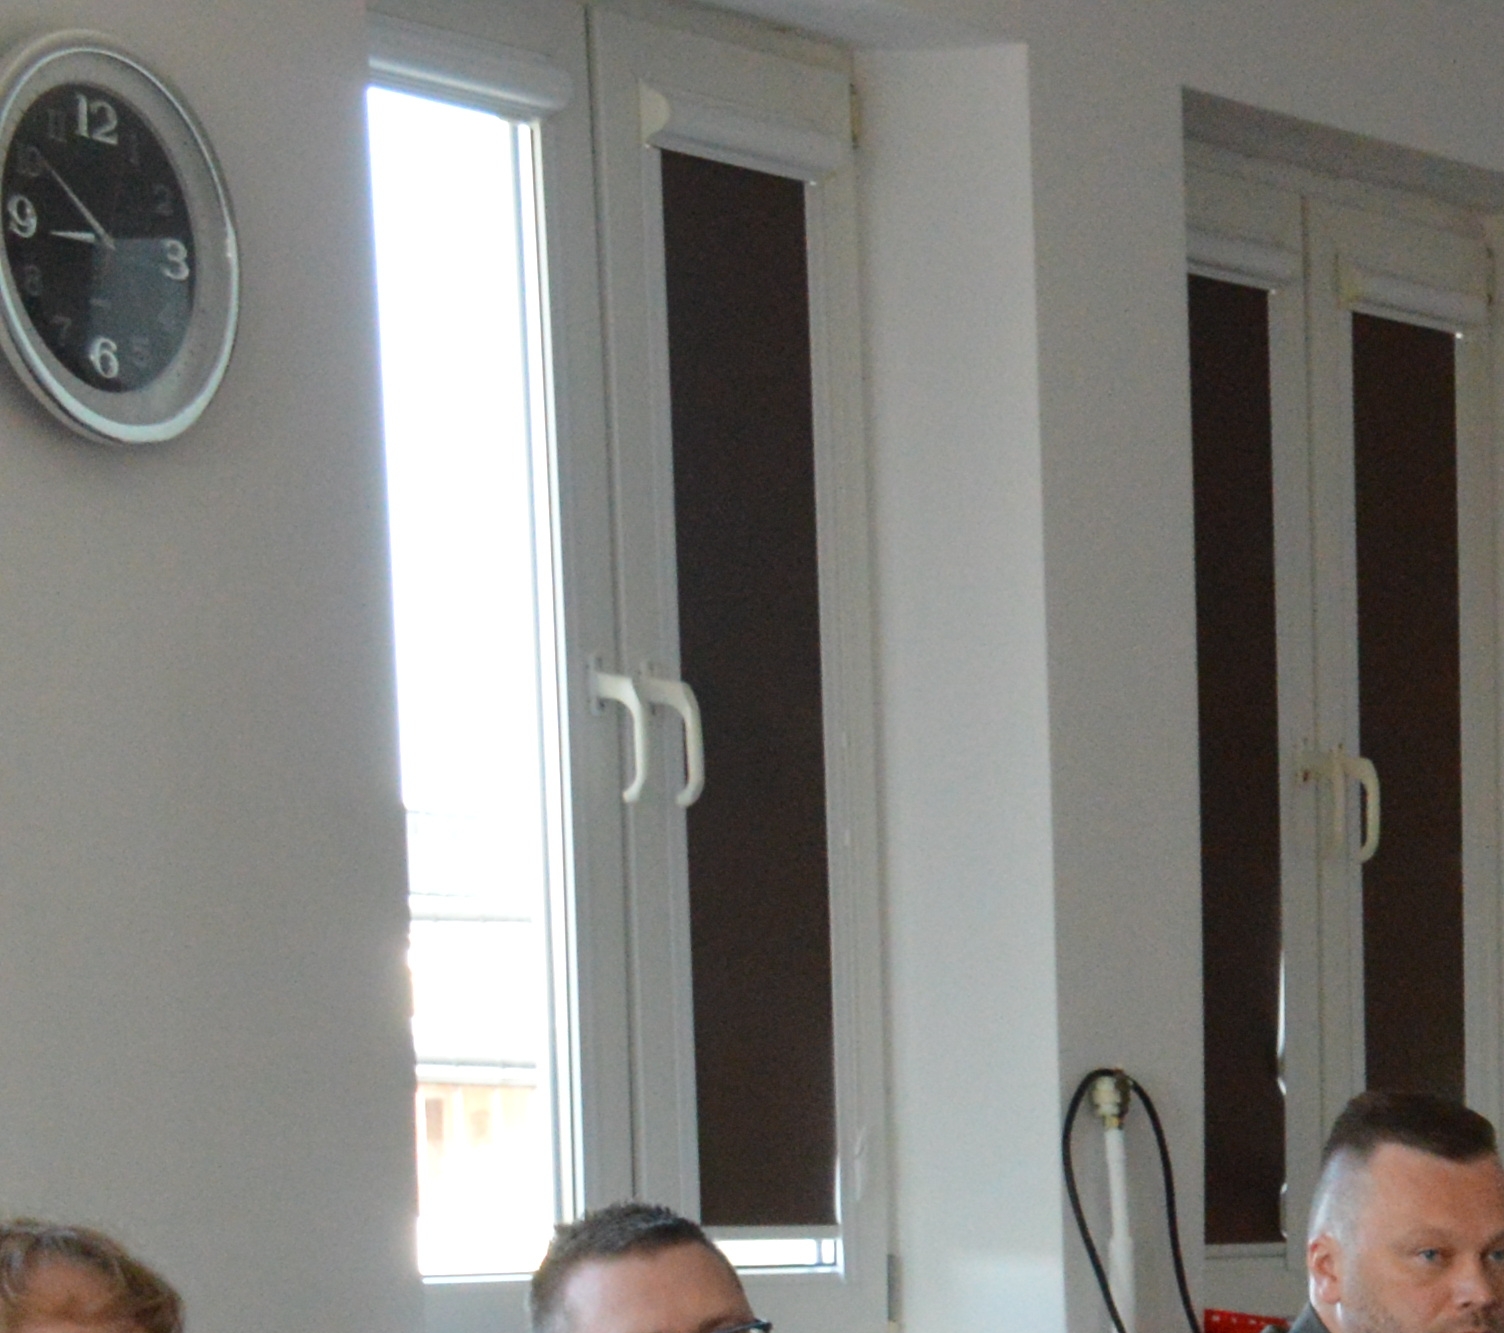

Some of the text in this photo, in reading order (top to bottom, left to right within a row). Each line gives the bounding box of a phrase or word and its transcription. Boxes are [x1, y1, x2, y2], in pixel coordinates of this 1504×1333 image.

[75, 94, 118, 145] 12
[7, 195, 38, 238] 9
[162, 239, 189, 281] 3
[88, 336, 120, 379] 6
